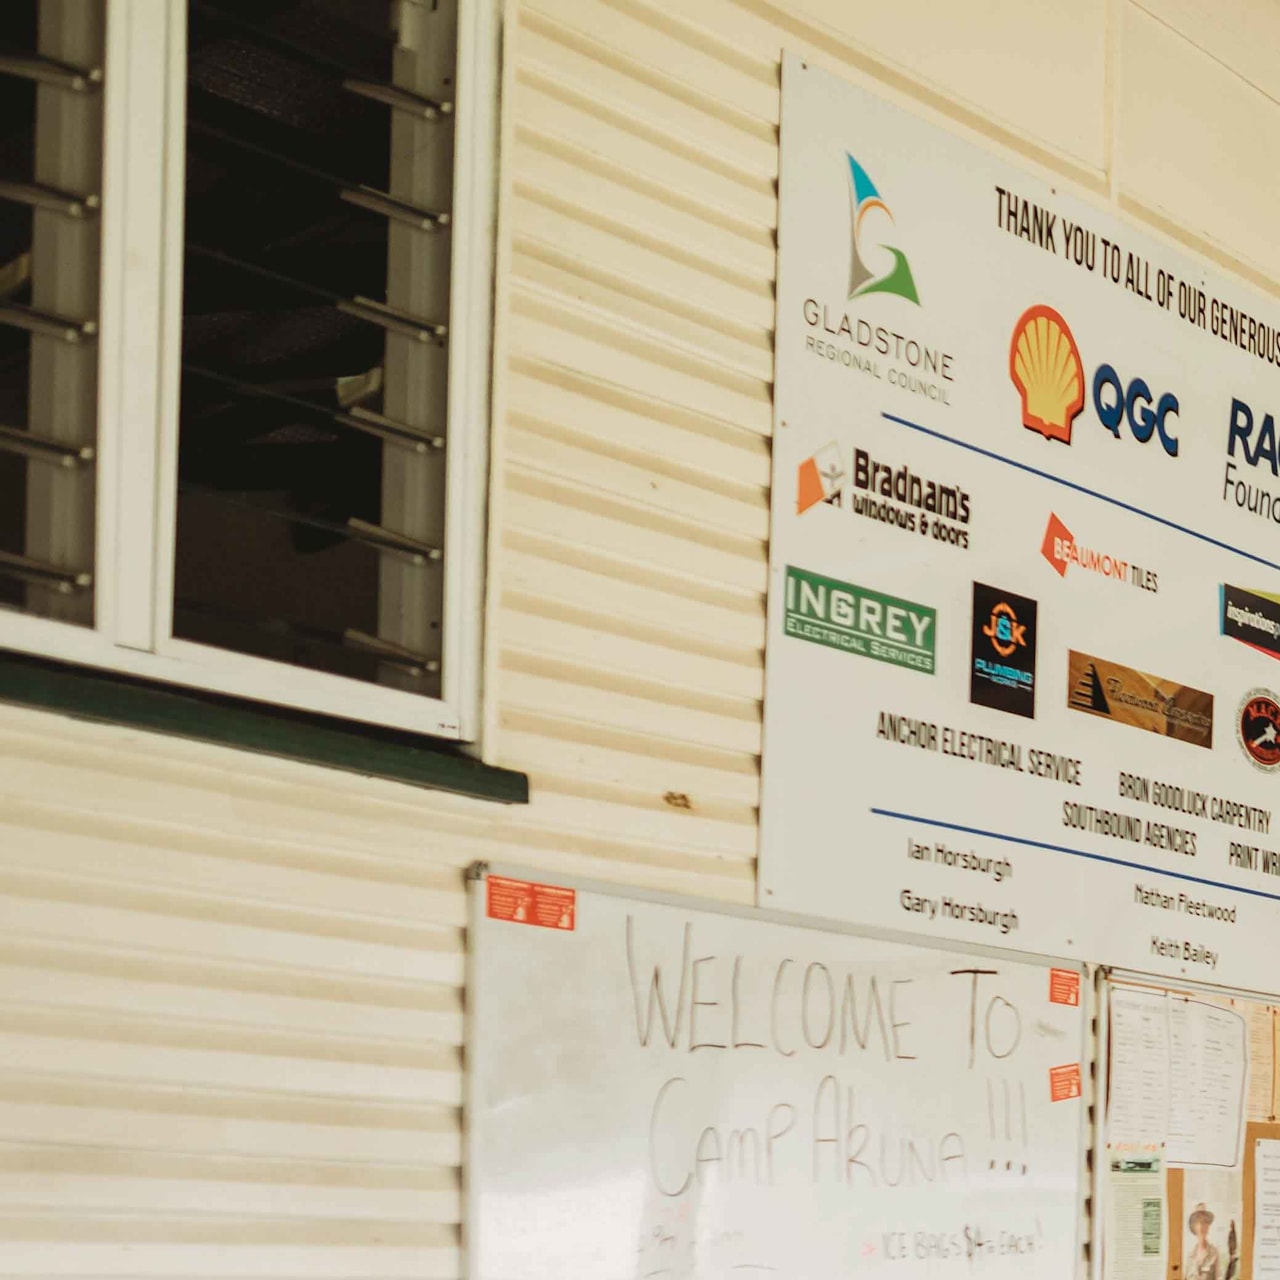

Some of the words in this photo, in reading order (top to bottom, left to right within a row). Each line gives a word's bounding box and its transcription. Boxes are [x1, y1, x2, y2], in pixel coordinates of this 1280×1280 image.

[995, 185, 1057, 254] THANK
[1062, 219, 1096, 272] YOU
[1101, 238, 1121, 284] TO
[1125, 252, 1153, 304] ALL
[1157, 269, 1175, 311] OF
[1178, 281, 1206, 331] OUR
[803, 298, 955, 382] GLADSTONE
[806, 335, 882, 379] REGIONAL
[888, 368, 951, 406] COUNCIL
[1093, 363, 1179, 457] QGC
[854, 447, 970, 524] Bradnam's
[853, 493, 915, 532] windows
[920, 513, 928, 536] &
[932, 517, 969, 549] doors
[1053, 535, 1128, 582] BEAUMONT
[1127, 564, 1158, 593] TILES
[786, 576, 932, 647] INGREY
[876, 711, 938, 752] ANCHOR
[941, 726, 1024, 773] ELECTRICAL
[1028, 748, 1083, 787] SERVICE
[1062, 800, 1142, 845] SOUTHBOUND
[1144, 821, 1198, 857] AGENCIES
[1153, 780, 1209, 819] GOODLUCK
[1211, 796, 1272, 835] CARPENTRY
[907, 836, 931, 863] Ian
[934, 843, 1013, 883] Horsburgh
[1228, 842, 1259, 871] PRINT
[900, 888, 938, 920] Gary
[942, 896, 1019, 935] Horsburgh
[1134, 884, 1174, 912] Nathan
[1178, 893, 1237, 925] Fleetwood
[1151, 935, 1180, 958] Keith
[1182, 941, 1218, 971] Bailey
[627, 915, 917, 1062] WELCOME
[950, 969, 1022, 1069] TO
[650, 1076, 795, 1197] CAMP
